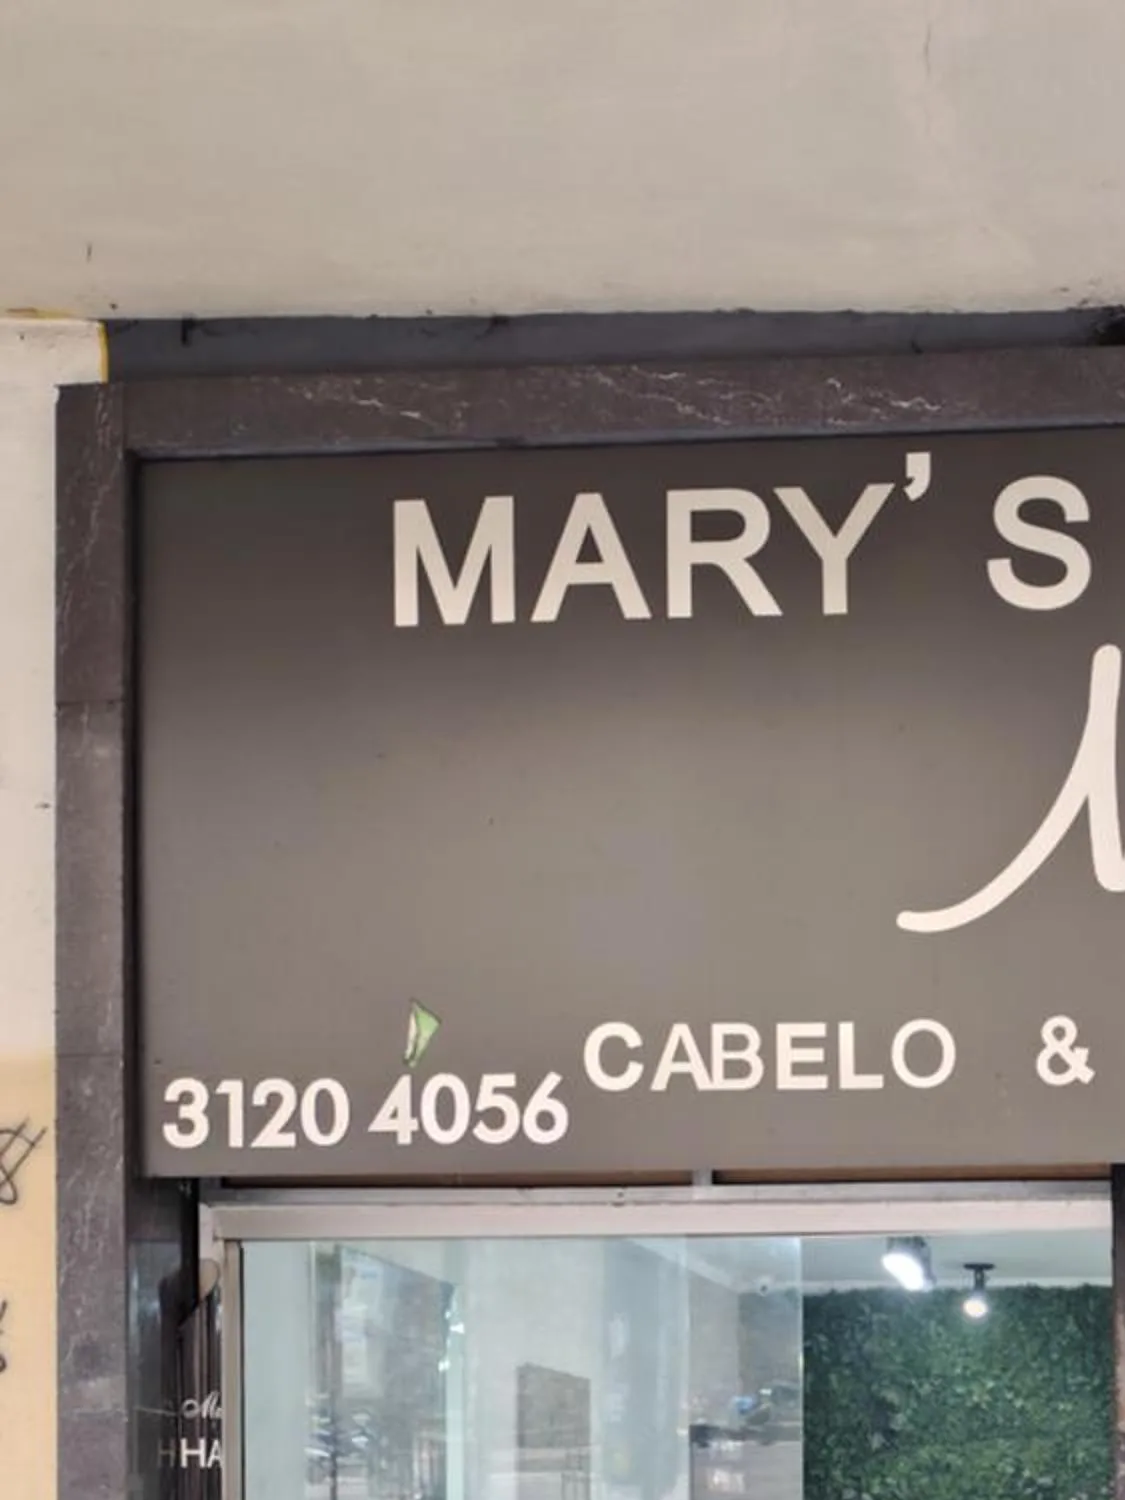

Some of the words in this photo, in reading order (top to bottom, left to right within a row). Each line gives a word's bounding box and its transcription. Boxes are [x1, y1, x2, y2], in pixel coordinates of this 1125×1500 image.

[584, 1019, 955, 1091] CABELO
[1037, 1016, 1094, 1085] &
[164, 1078, 349, 1148] 3120
[368, 1072, 568, 1144] 4056
